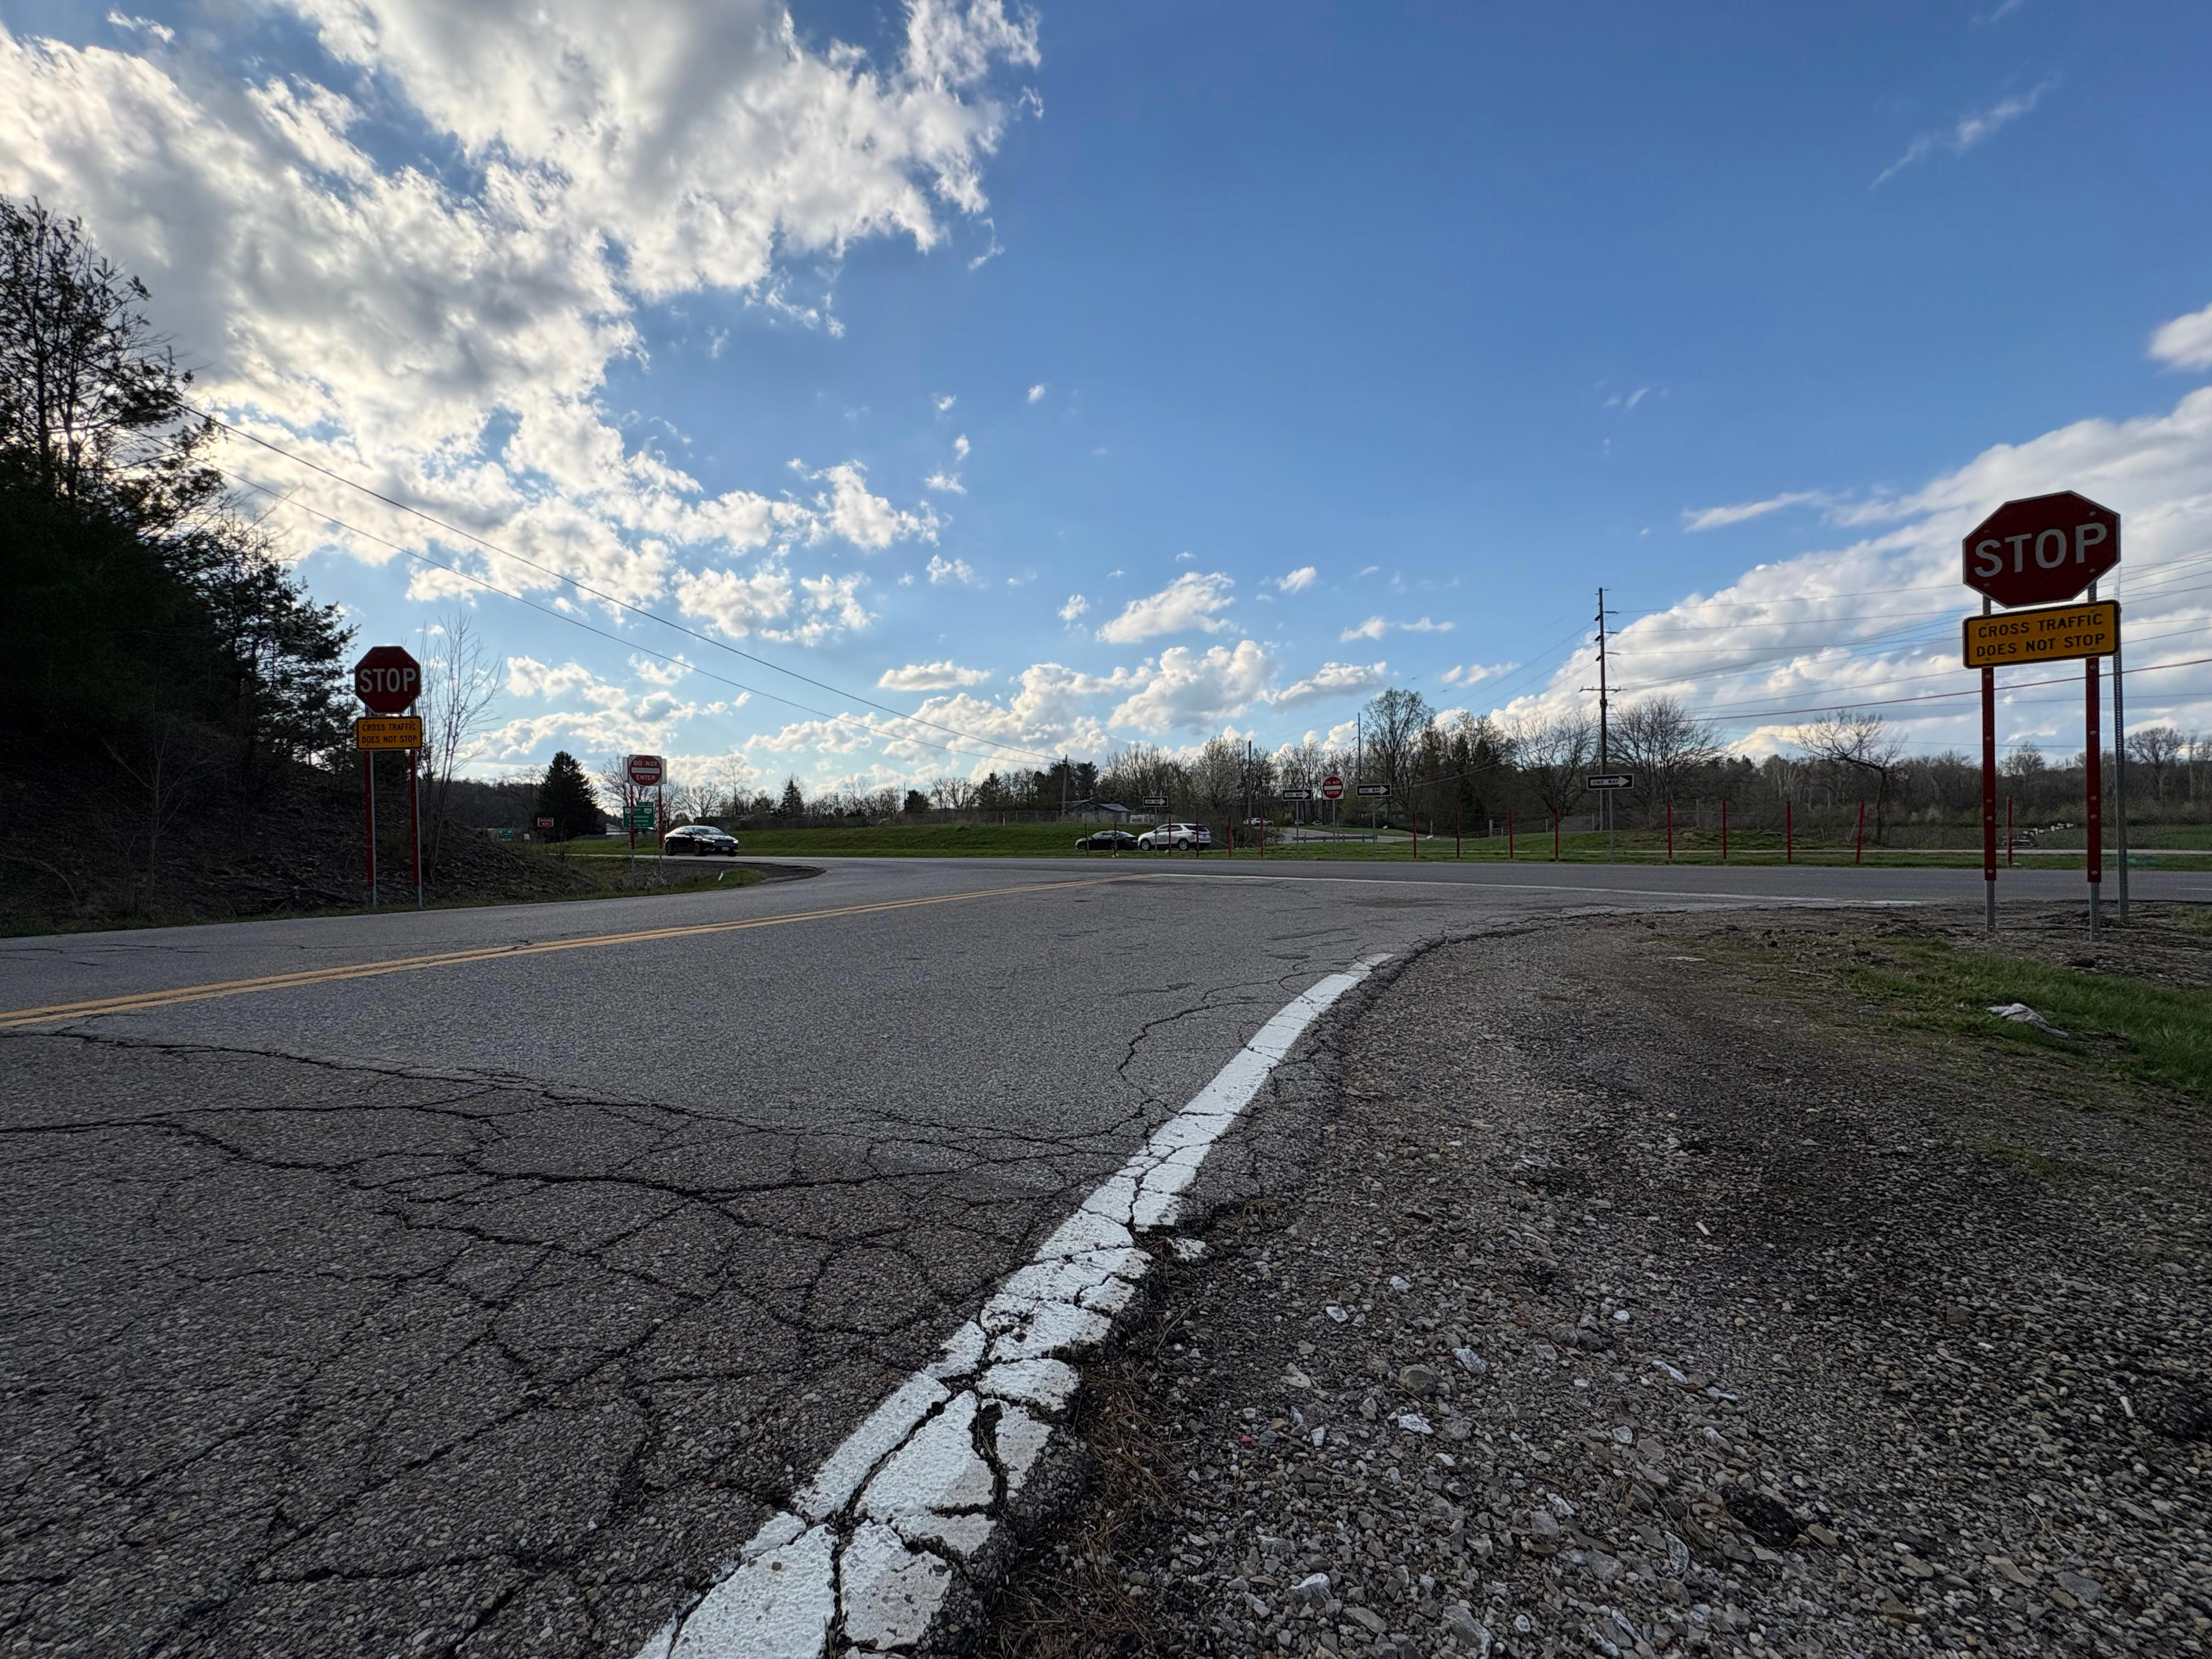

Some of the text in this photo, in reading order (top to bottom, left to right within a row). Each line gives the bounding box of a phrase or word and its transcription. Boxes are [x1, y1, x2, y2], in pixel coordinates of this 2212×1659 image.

[1974, 522, 2108, 577] STOP
[1978, 613, 2103, 638] CROSS TRAFFIC
[1976, 633, 2105, 657] DOES NOT STOP
[359, 668, 417, 693] STOP
